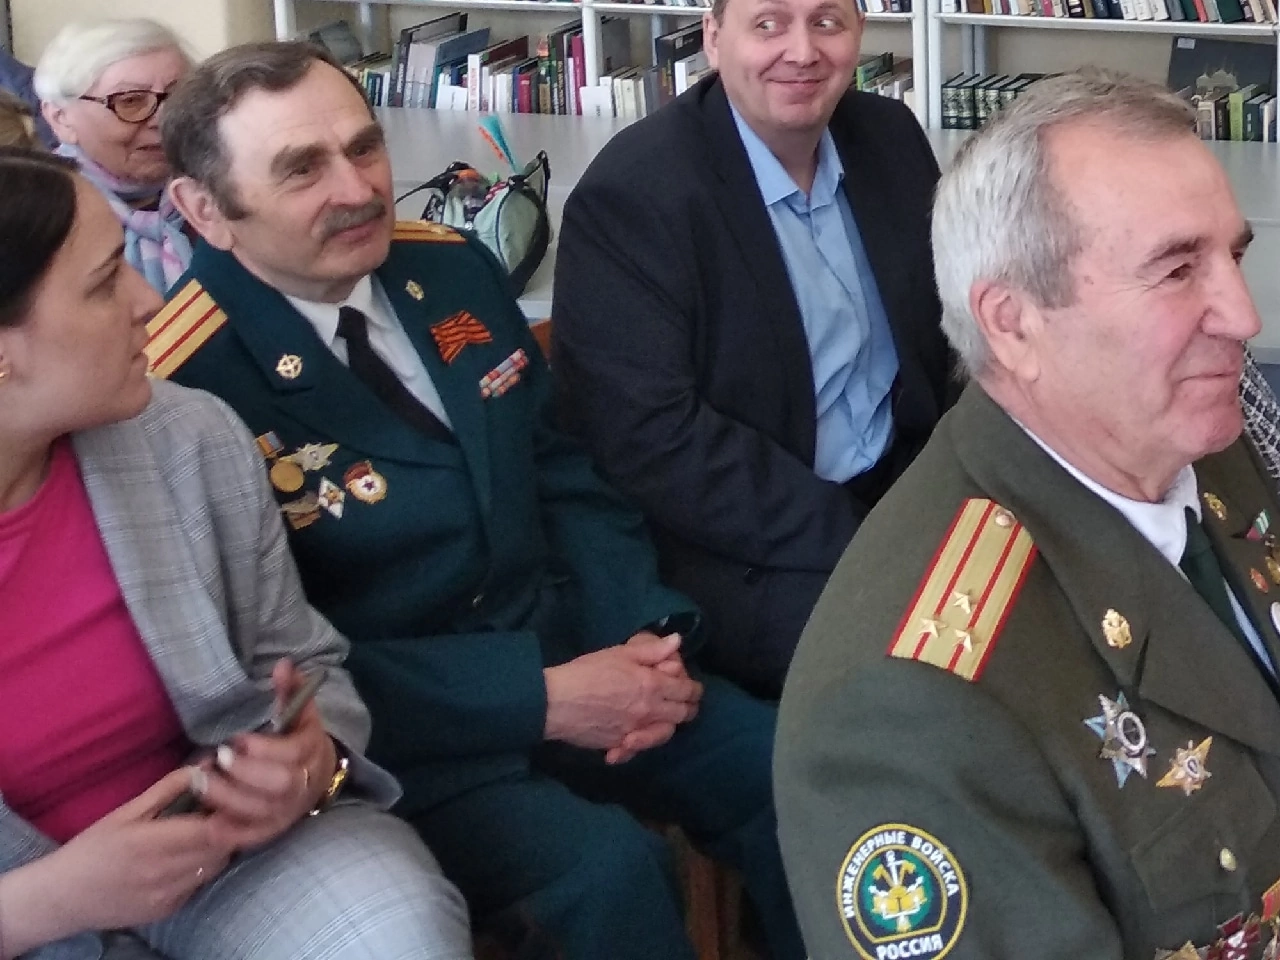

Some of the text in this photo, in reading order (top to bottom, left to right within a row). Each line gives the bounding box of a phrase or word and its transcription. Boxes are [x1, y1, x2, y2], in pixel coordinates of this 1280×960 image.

[842, 830, 960, 919] ИНЖЕНЕРНЫЕ ВОЙСКА
[876, 933, 944, 960] РОССИЯ
